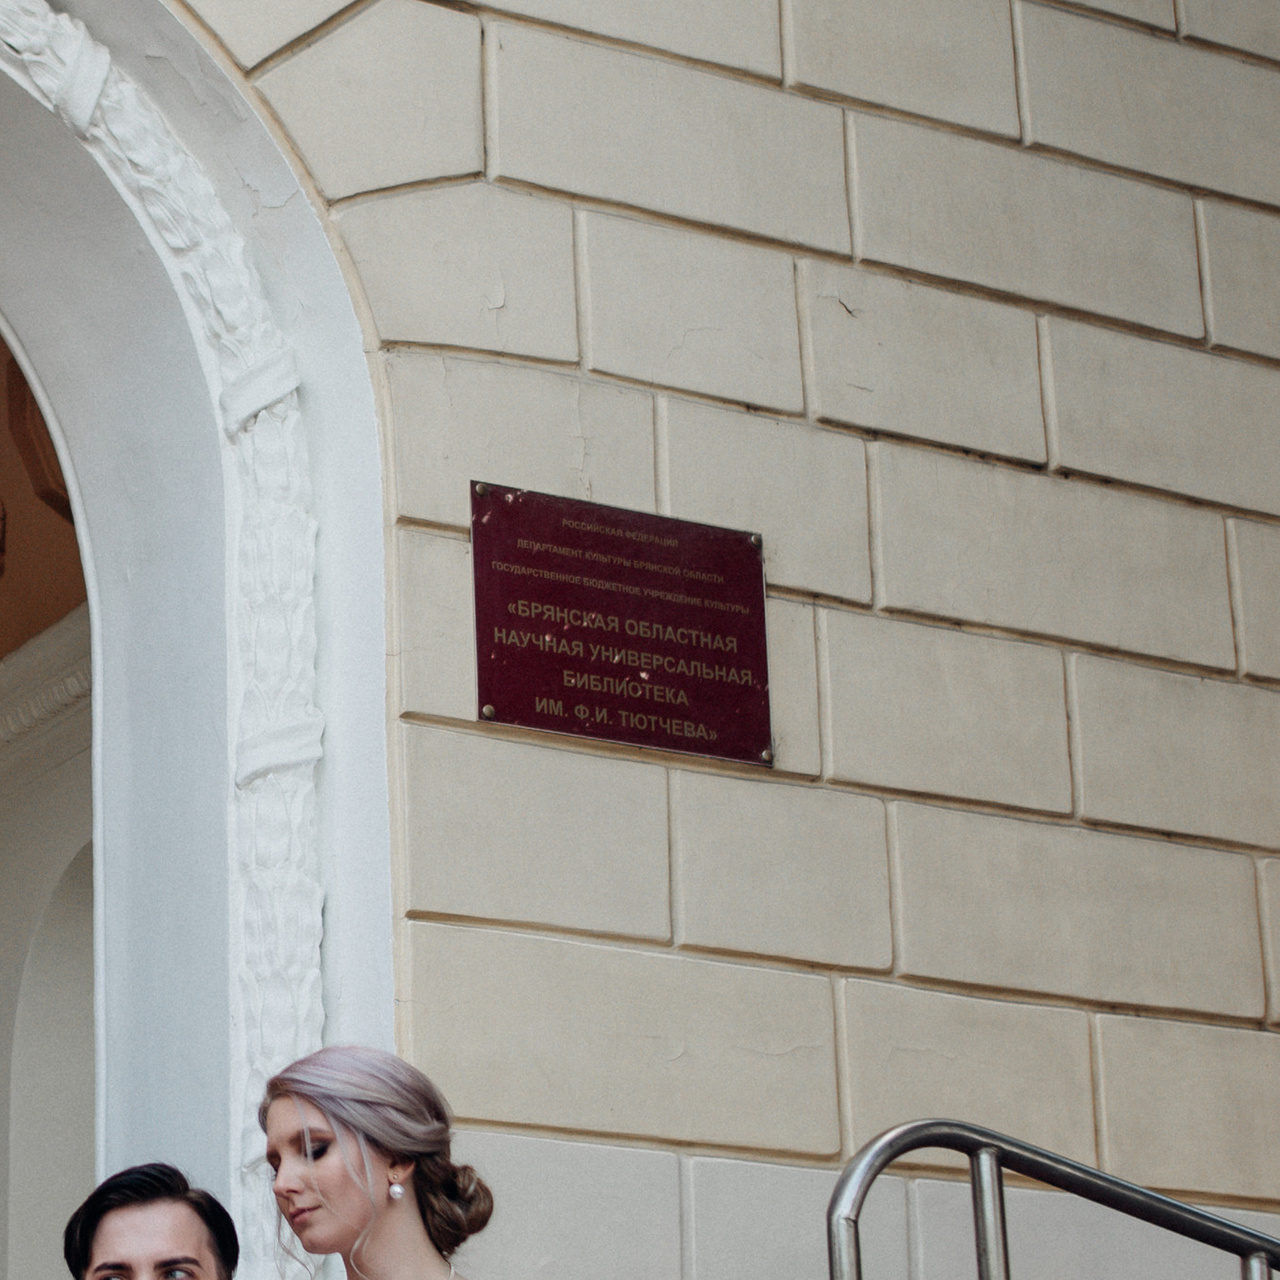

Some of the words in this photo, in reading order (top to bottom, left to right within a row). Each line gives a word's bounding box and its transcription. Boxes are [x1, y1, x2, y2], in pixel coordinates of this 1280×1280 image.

[562, 519, 622, 537] РОССИЙСКАЯ
[625, 531, 679, 548] ФЕДЕРАЦИЯ
[517, 538, 583, 559] ДЕПАРТАМЕНТ
[585, 550, 631, 567] КУЛЬТУРЫ
[633, 560, 681, 577] БРЯНСКОЙ
[684, 570, 724, 584] ОБЛАСТИ
[491, 561, 581, 585] ГОСУДАРСТВЕННОЕ
[583, 577, 641, 596] БЮДЖЕТНОЕ
[643, 588, 702, 607] УЧРЕЖДЕНИЕ
[704, 599, 750, 615] КУЛЬТУРЫ
[507, 599, 619, 632] «БРЯНСКАЯ
[625, 619, 737, 653] ОБЛАСТНАЯ
[494, 627, 583, 658] НАУЧНАЯ
[589, 643, 752, 686] УНИВЕРСАЛЬНАЯ
[563, 670, 689, 706] БИБЛИОТЕКА
[535, 696, 568, 717] ИМ.
[574, 704, 613, 725] Ф.И.
[618, 710, 718, 741] ТЮТЧЕВА»
